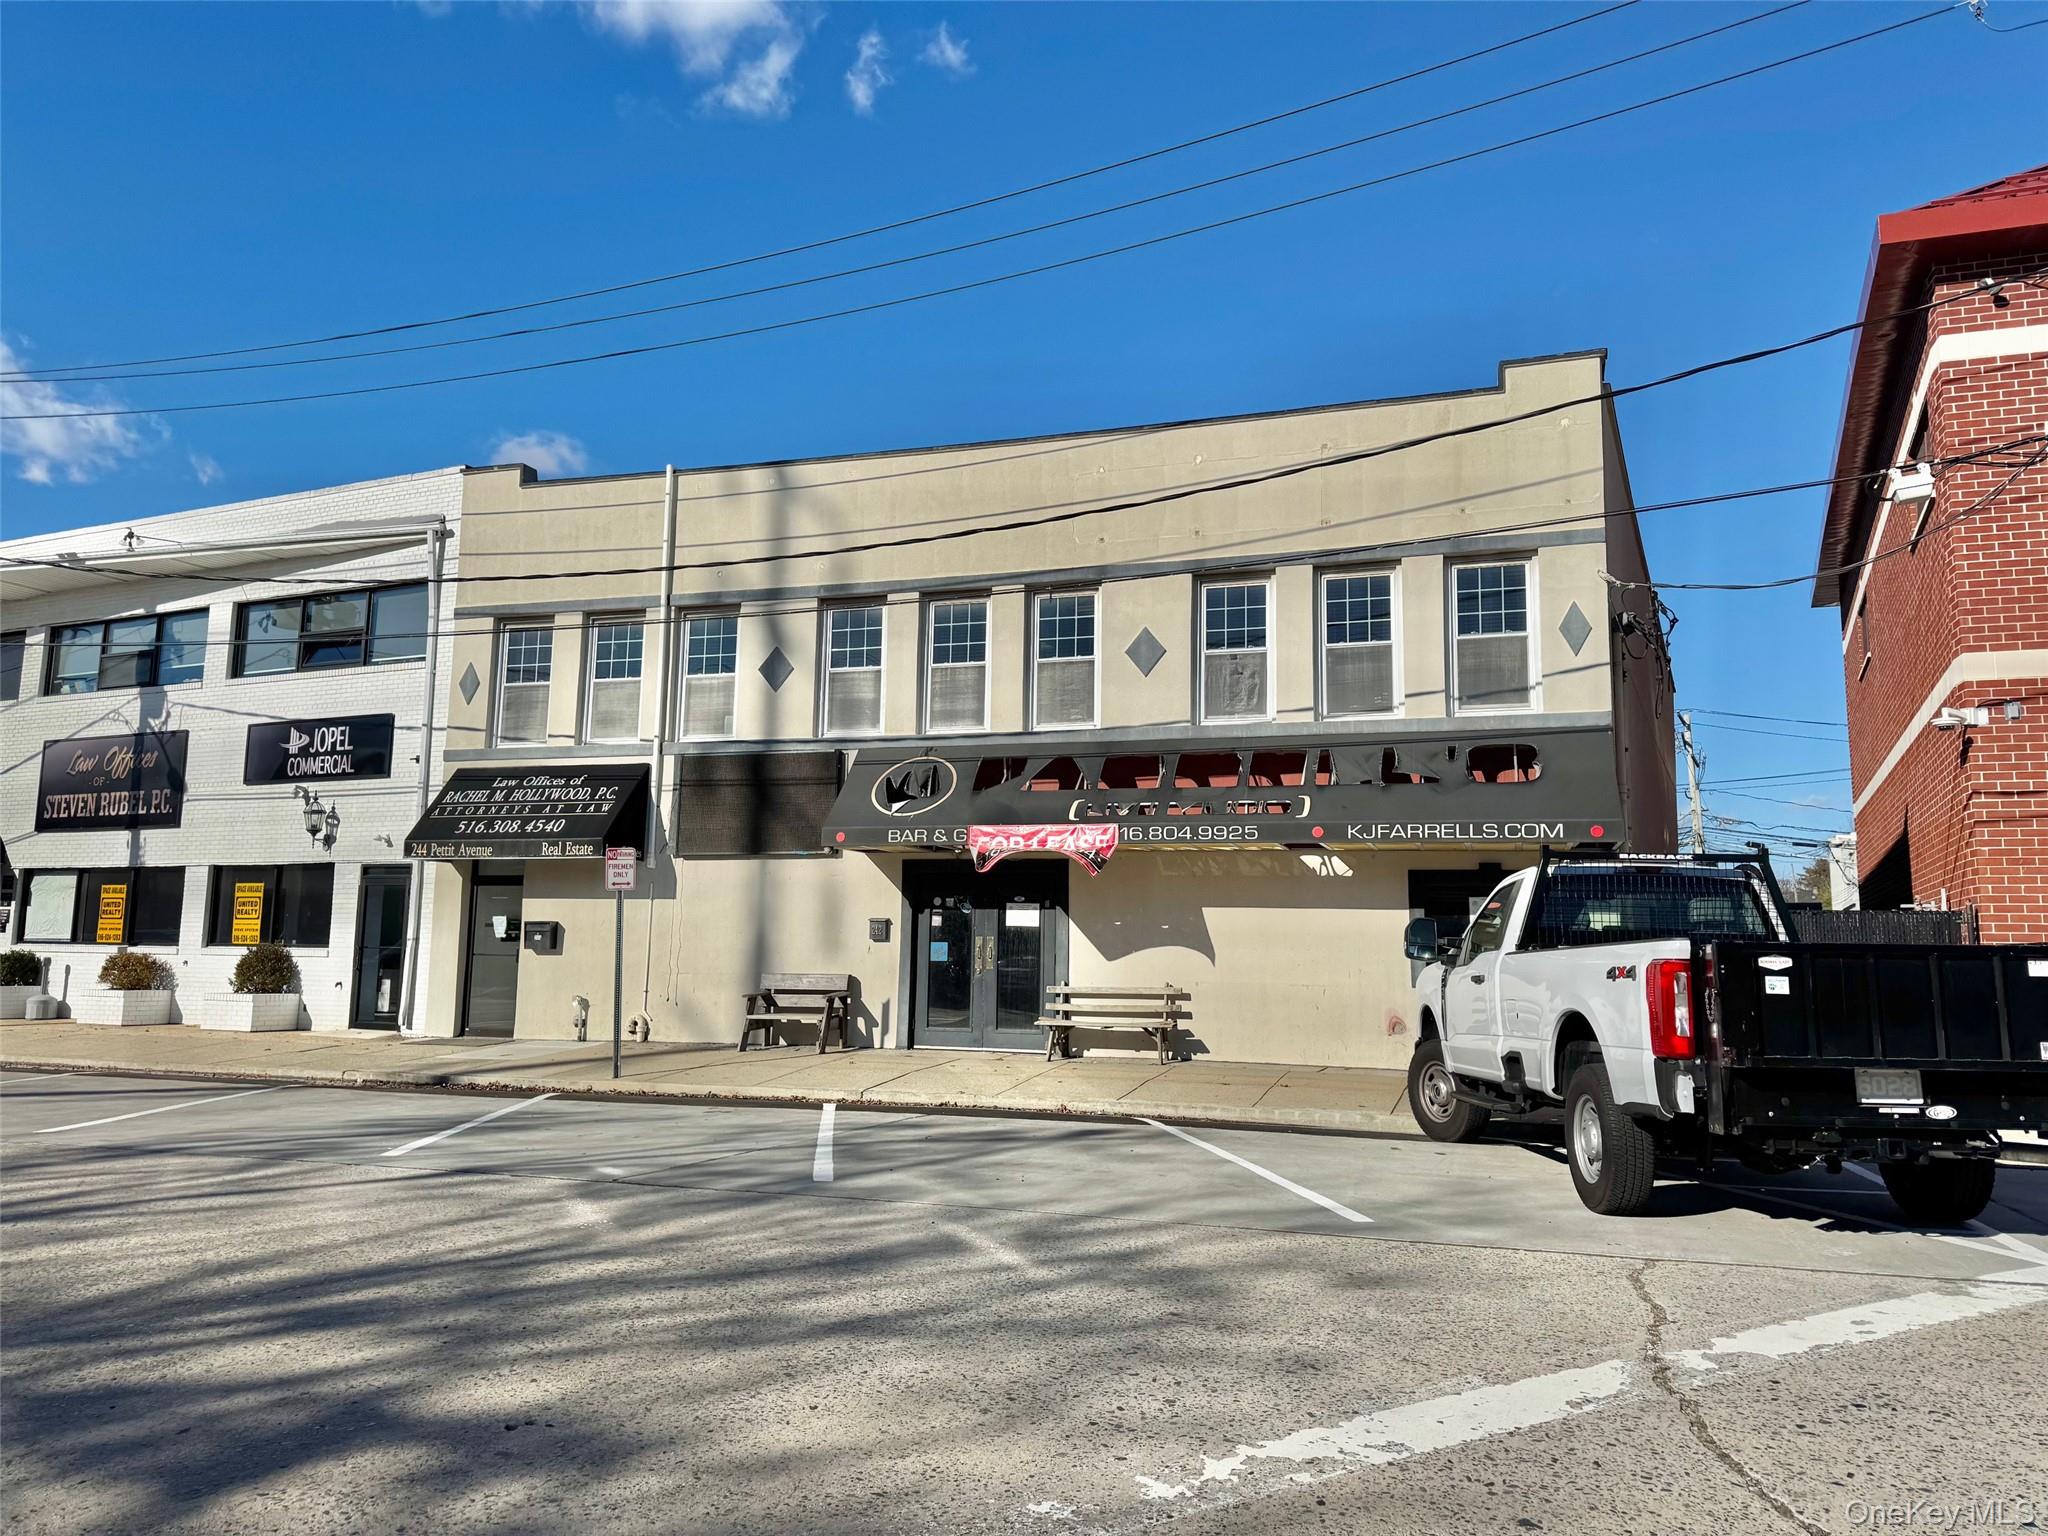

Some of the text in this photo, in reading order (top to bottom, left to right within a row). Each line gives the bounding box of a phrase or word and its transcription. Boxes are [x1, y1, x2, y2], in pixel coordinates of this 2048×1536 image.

[309, 726, 353, 753] JOPEL
[65, 744, 159, 779] Law Offices
[287, 755, 355, 776] COMMERCIAL
[492, 774, 587, 787] Law Offices of
[441, 786, 617, 804] RACHEL M. HOLLYWOOD, P.C.
[44, 788, 173, 819] STEVEN RUBEL P.C.
[431, 803, 613, 817] ATTORNEYS AT LAW
[454, 818, 566, 834] 516.308.4540
[1119, 826, 1259, 841] 16.804.9925
[1346, 823, 1564, 840] KJFARRELLS.COM
[888, 829, 929, 843] BAR
[933, 829, 947, 843] &
[411, 842, 493, 857] 244 Pettit Avenue
[542, 841, 593, 856] Real Estate
[607, 850, 617, 860] NO
